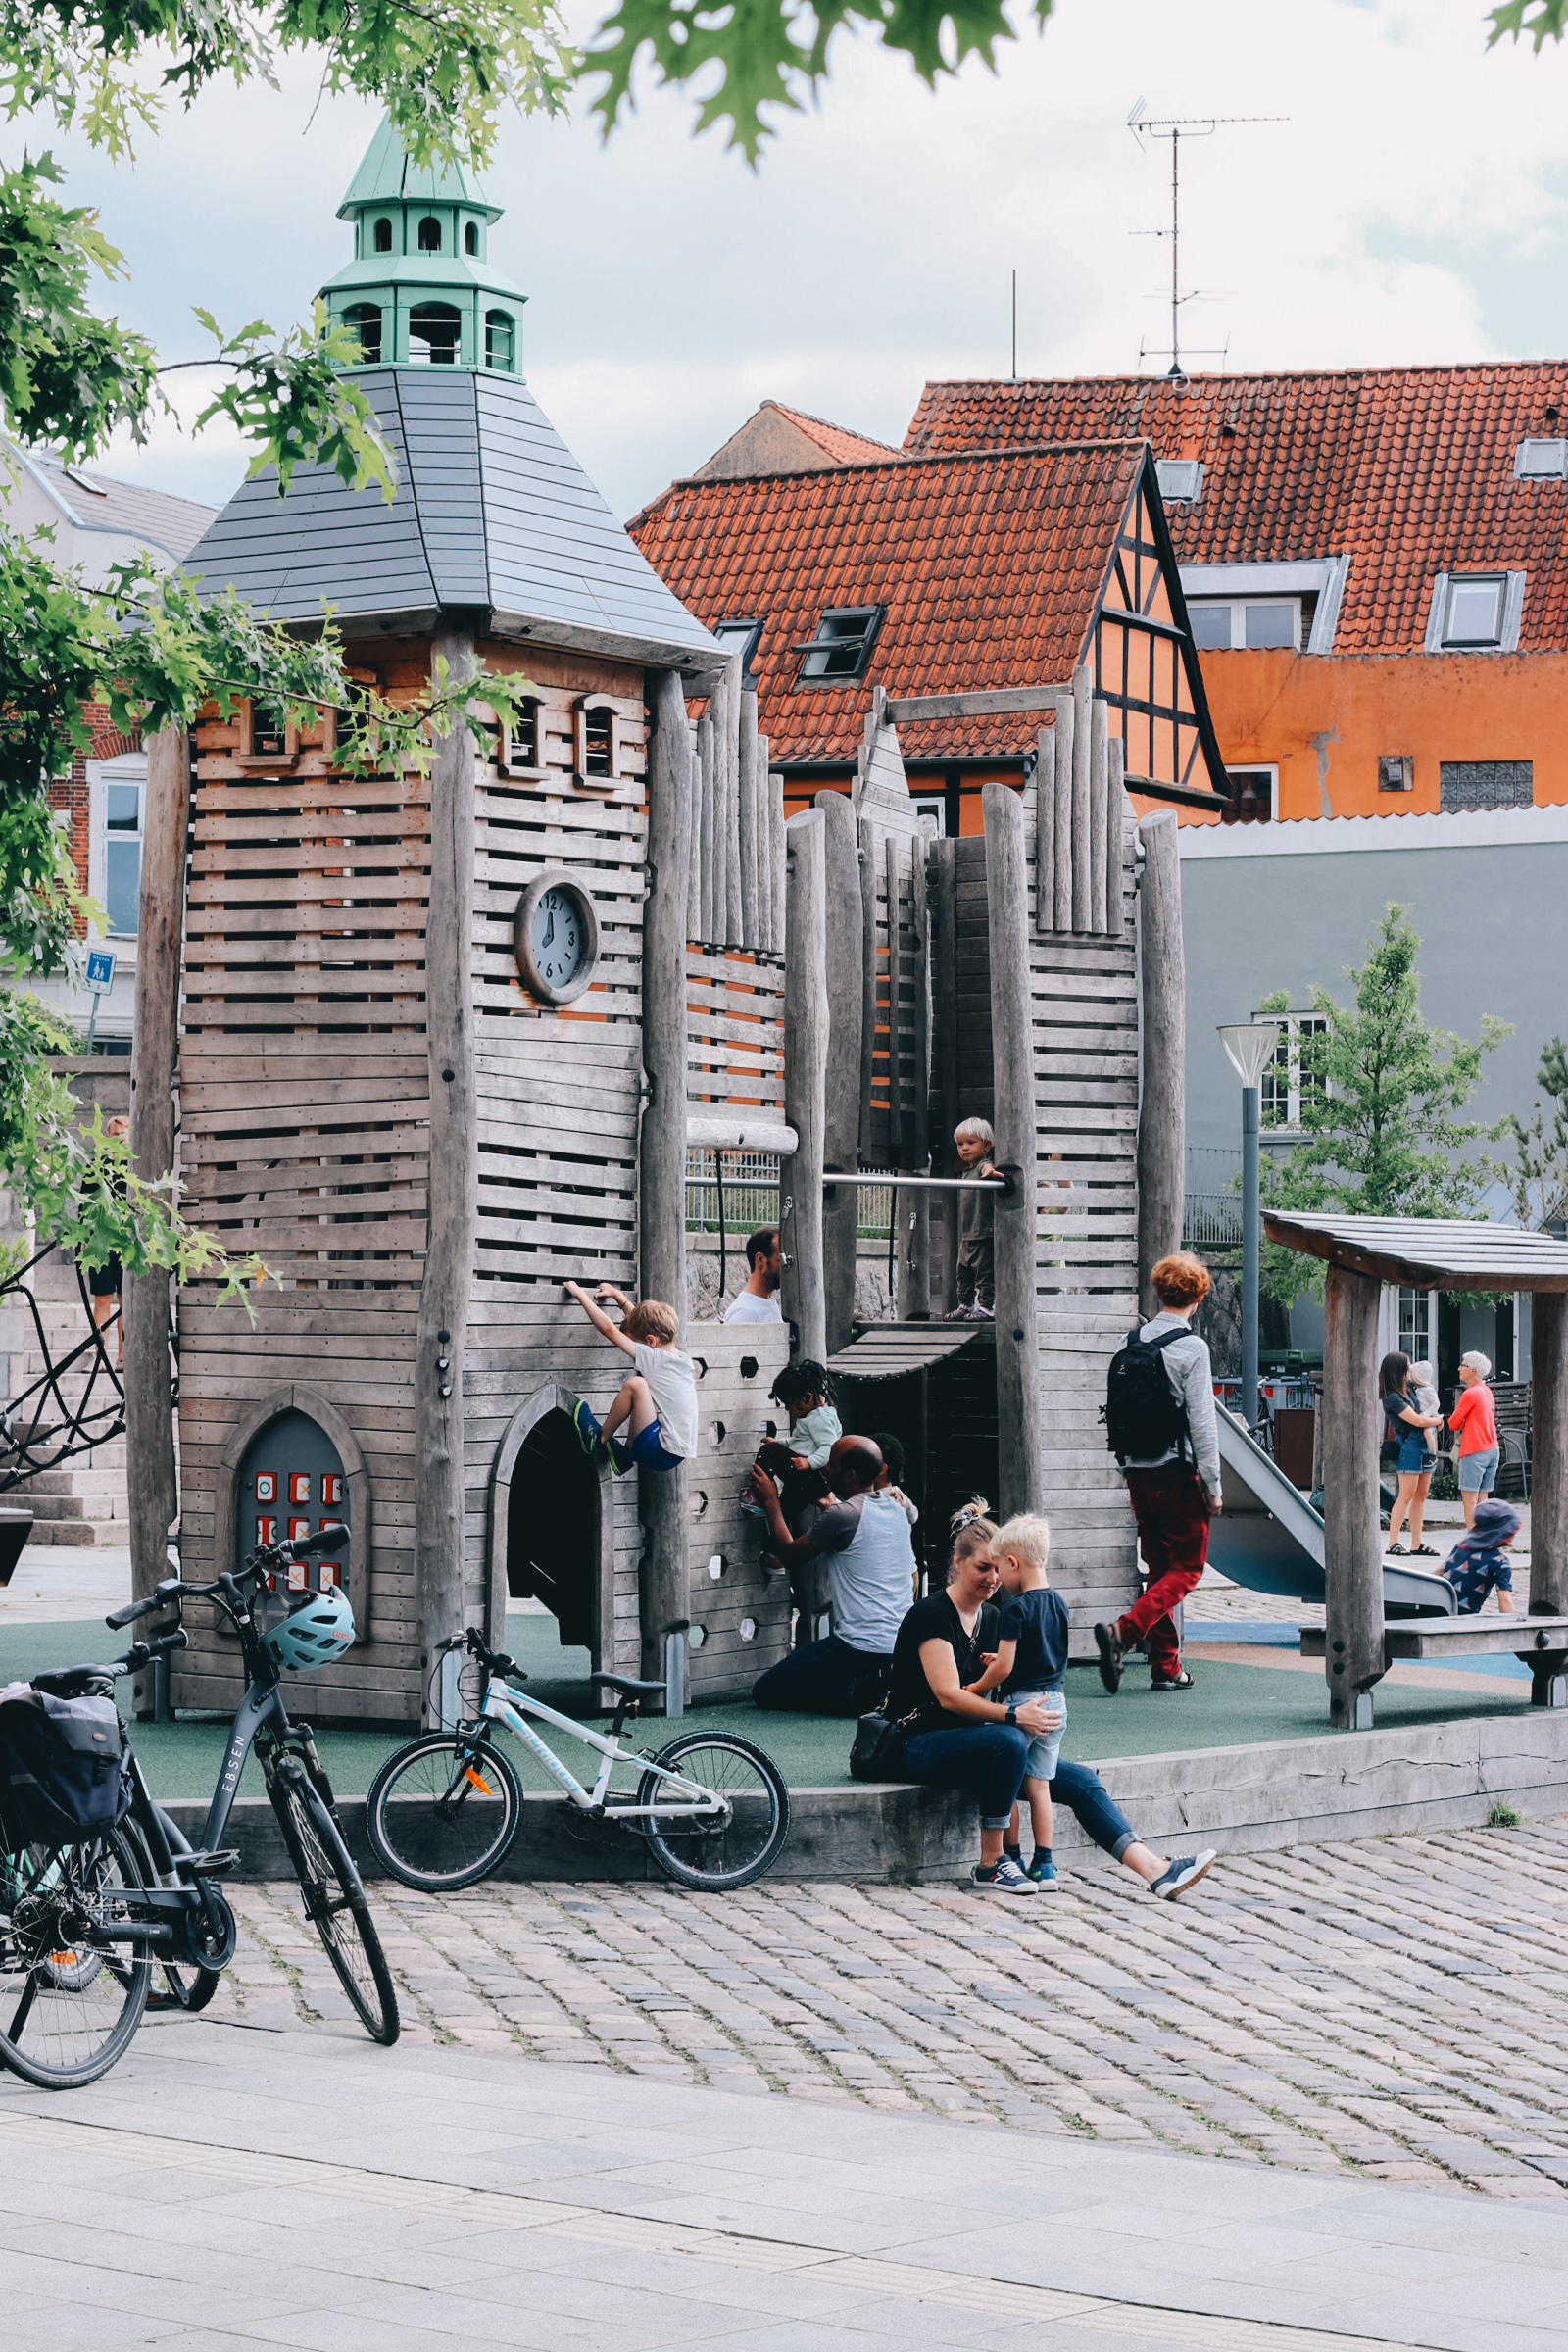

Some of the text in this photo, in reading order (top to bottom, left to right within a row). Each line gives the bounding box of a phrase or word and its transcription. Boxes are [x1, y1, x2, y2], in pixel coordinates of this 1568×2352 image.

[545, 893, 558, 910] 12
[567, 930, 575, 948] 3
[545, 962, 553, 978] 6
[221, 1735, 246, 1792] EBSEN
